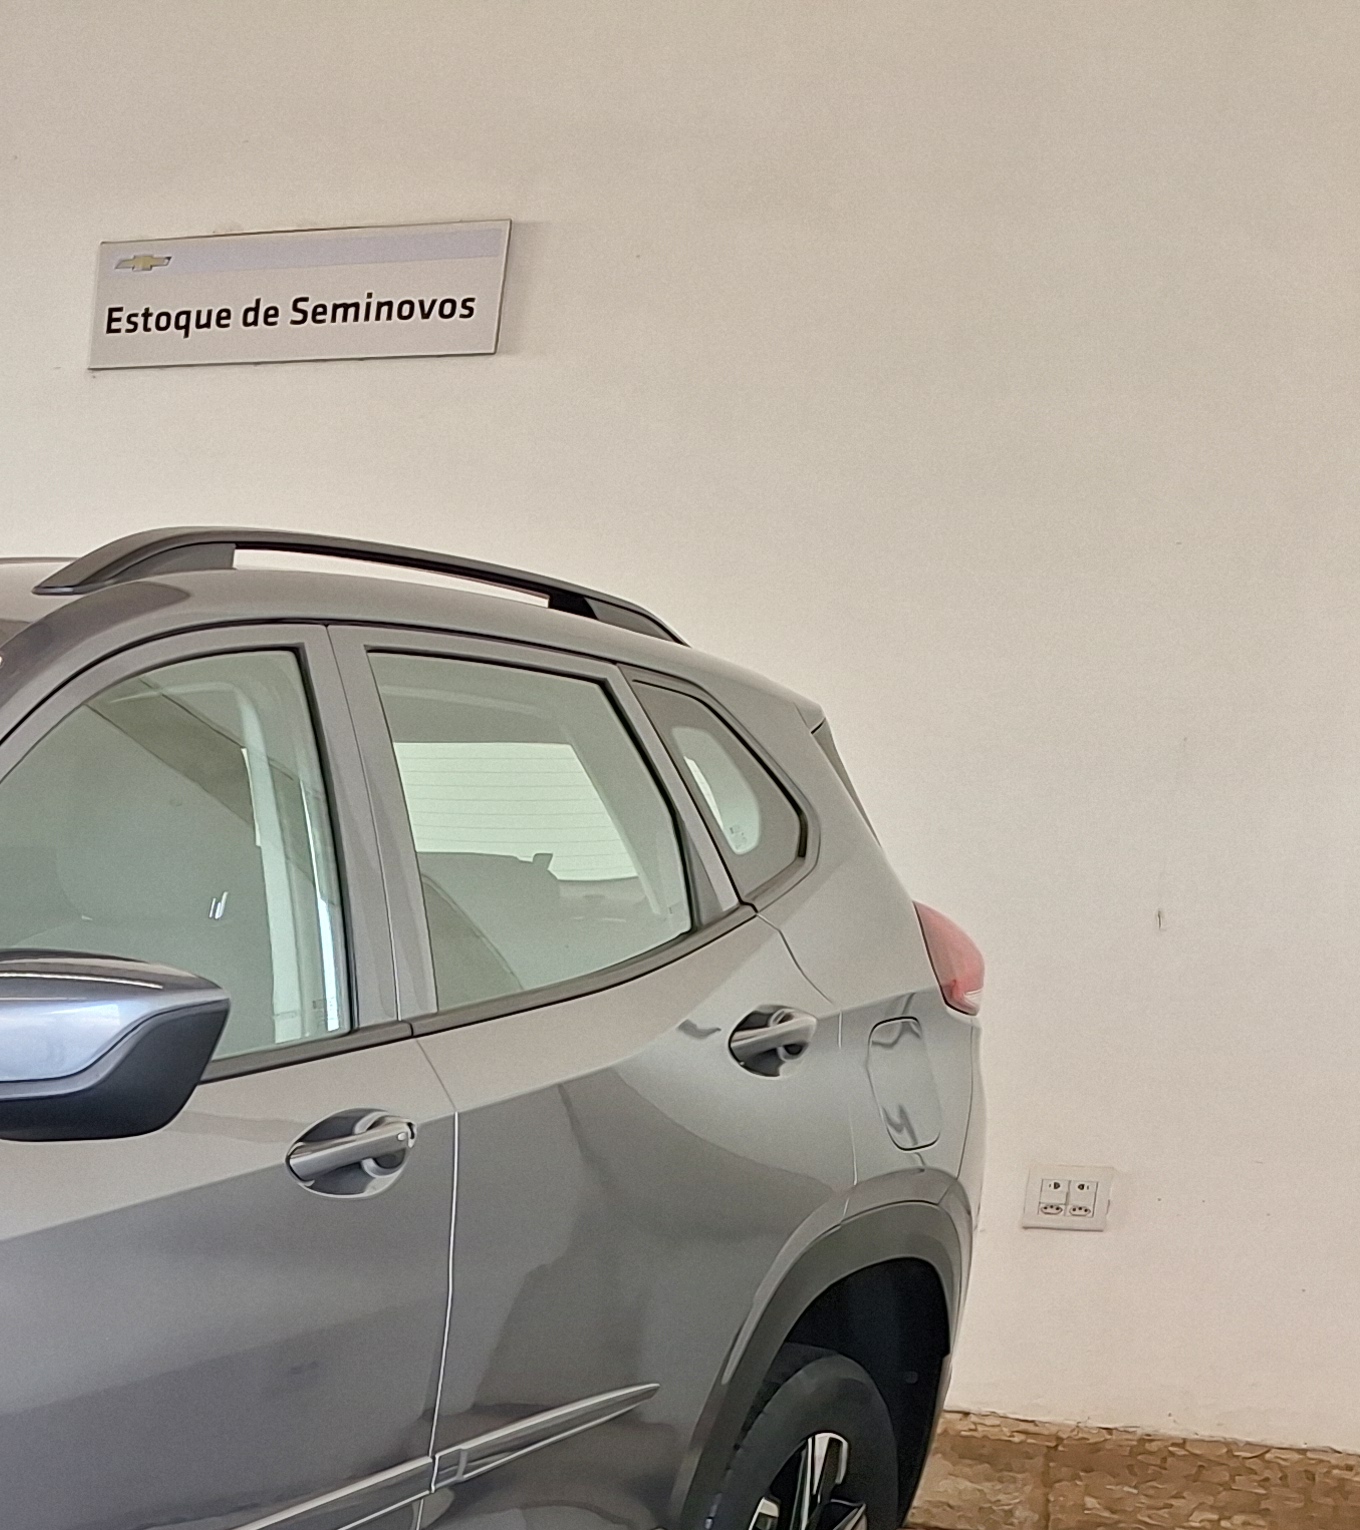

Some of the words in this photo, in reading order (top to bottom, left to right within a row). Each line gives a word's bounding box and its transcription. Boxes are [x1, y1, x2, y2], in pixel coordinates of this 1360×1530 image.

[105, 305, 231, 339] Estoque
[242, 297, 279, 328] de
[289, 292, 476, 326] Seminovos
